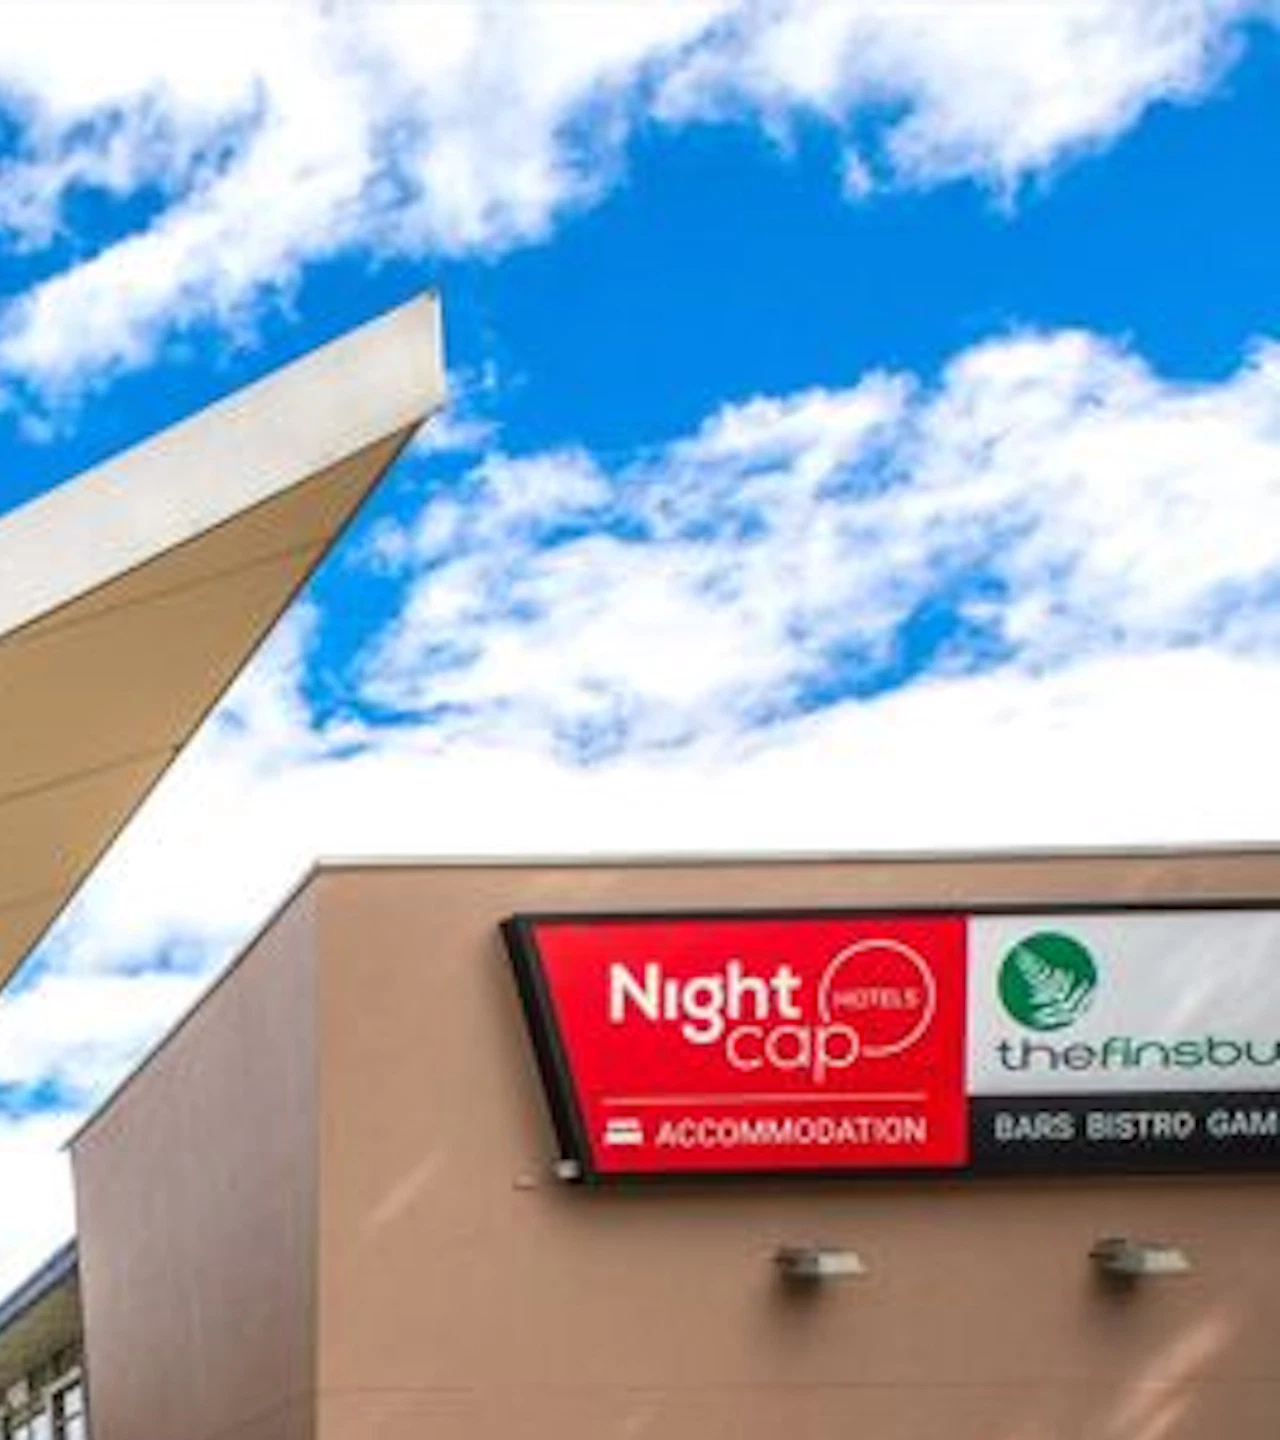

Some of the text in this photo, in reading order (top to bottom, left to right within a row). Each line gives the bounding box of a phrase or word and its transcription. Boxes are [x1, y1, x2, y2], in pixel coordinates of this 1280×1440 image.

[608, 957, 803, 1044] Night
[832, 986, 919, 1010] HOTELS
[725, 1023, 860, 1085] cap
[654, 1114, 928, 1148] ACCOMMODATION
[993, 1111, 1076, 1141] BARS
[1085, 1111, 1195, 1140] BISTRO
